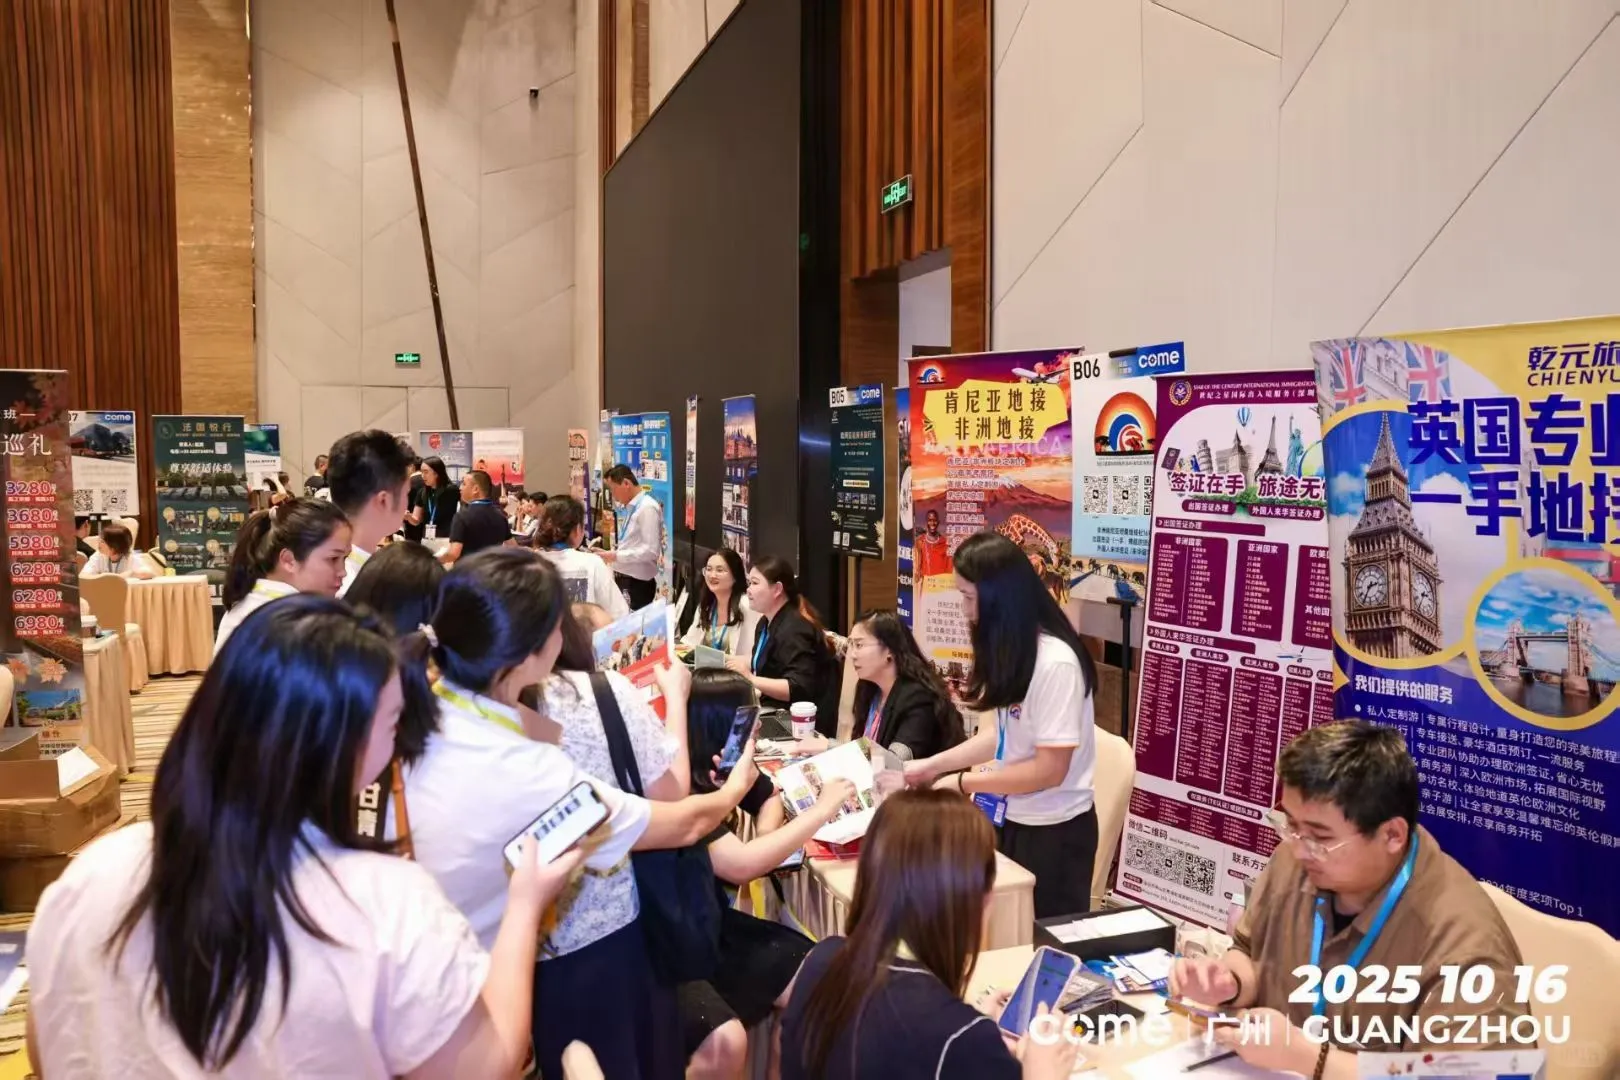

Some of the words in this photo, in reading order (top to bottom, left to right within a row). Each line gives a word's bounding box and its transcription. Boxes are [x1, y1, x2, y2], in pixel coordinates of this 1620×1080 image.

[1138, 350, 1180, 368] come
[1073, 358, 1101, 380] B06
[831, 390, 845, 404] B05
[861, 388, 881, 399] come
[944, 388, 1047, 414] 肯尼亚地接
[954, 415, 1035, 440] 非洲地接
[0, 433, 52, 456] 巡礼
[6, 481, 51, 495] 3280
[1171, 472, 1244, 495] 签证在手
[1258, 476, 1326, 499] 旅途无
[7, 508, 53, 523] 3680
[1252, 506, 1321, 519] 外国人来华签证办理
[9, 535, 54, 550] 5980
[1248, 543, 1278, 554] 亚洲国家
[11, 562, 55, 577] 6280
[13, 589, 56, 603] 6280
[1305, 605, 1332, 617] 其他国
[15, 616, 58, 630] 6980
[1154, 629, 1215, 647] 外国人来华签证办理
[1355, 674, 1453, 704] 我们提供的服务
[1367, 705, 1419, 722] 私人定制游
[1421, 758, 1452, 775] 商务游
[1459, 766, 1606, 812] 深入欧洲市场，拓展国际视野
[1421, 788, 1452, 804] 亲子游
[1128, 820, 1168, 841] 微信二维码
